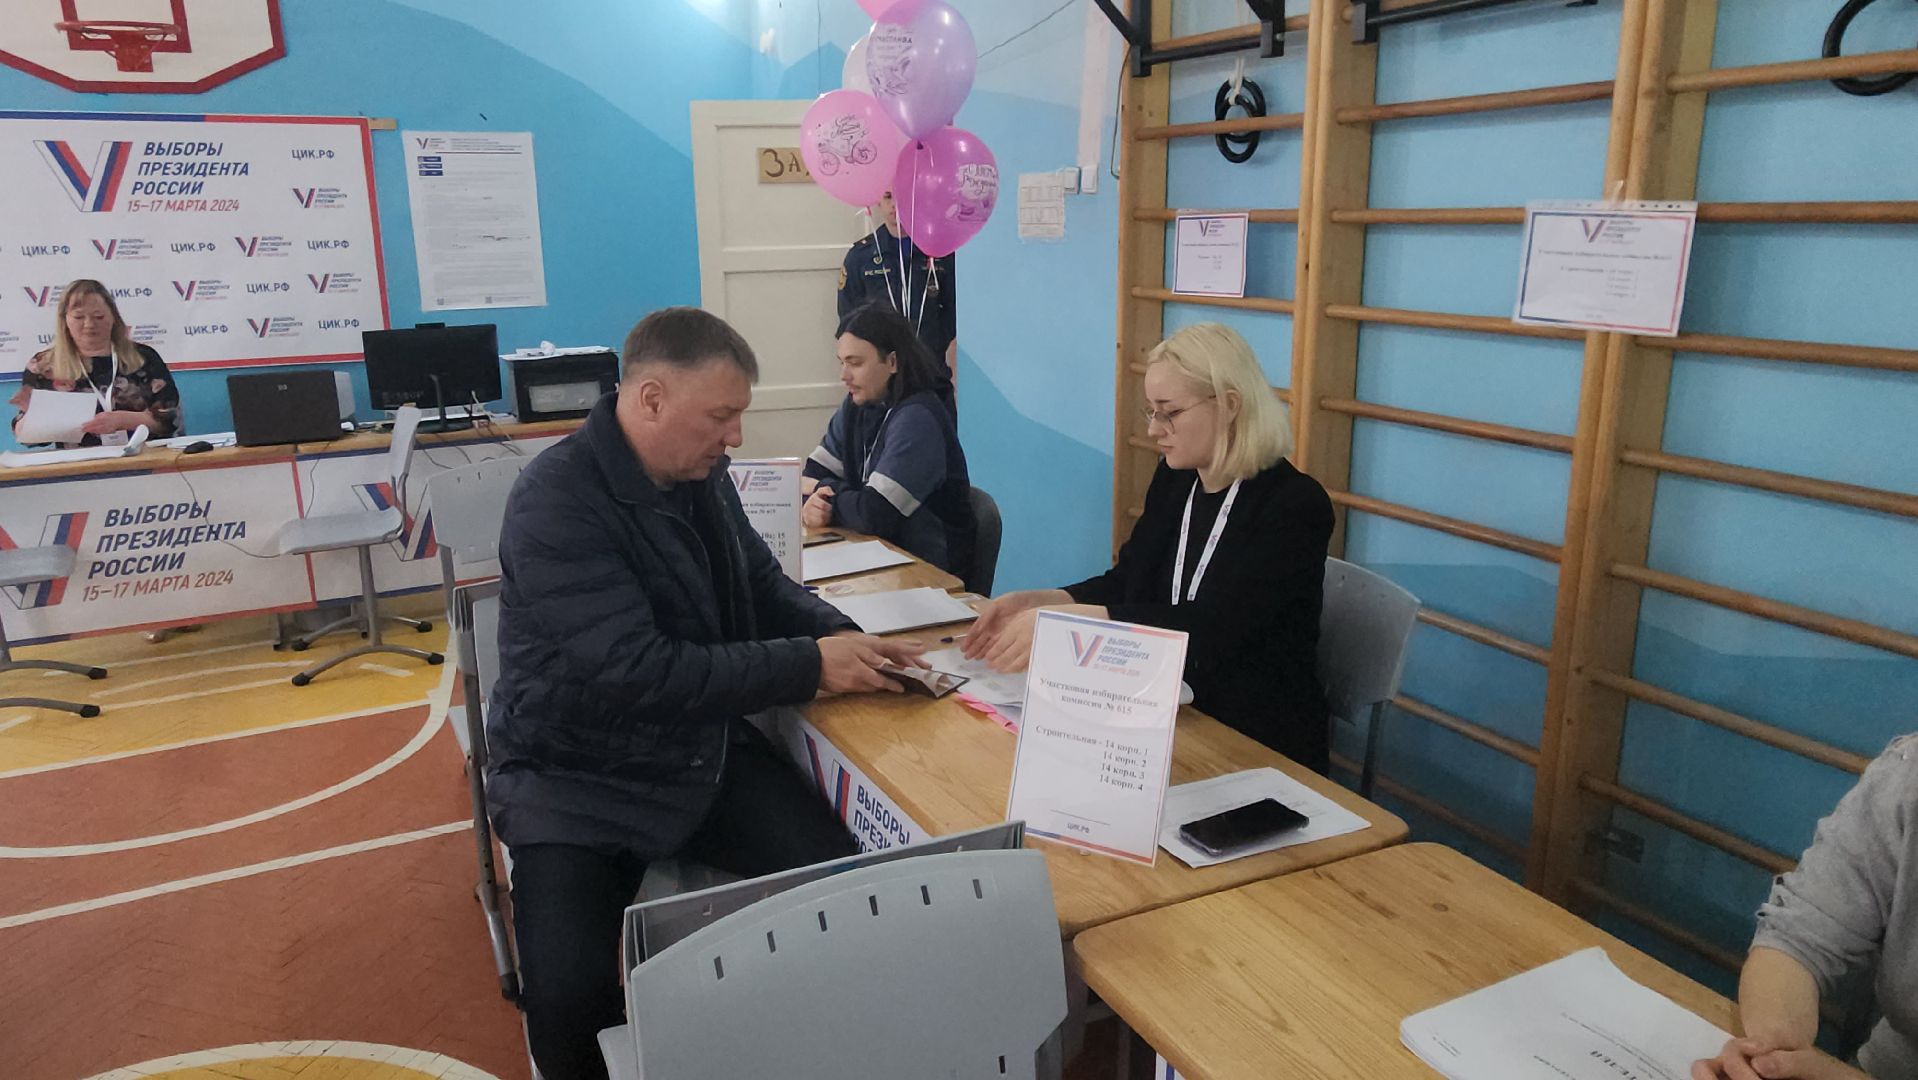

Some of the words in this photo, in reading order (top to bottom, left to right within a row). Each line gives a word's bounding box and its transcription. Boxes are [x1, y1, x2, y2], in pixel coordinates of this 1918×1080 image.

[143, 141, 223, 156] ВЫБОРЫ
[291, 149, 335, 160] ЦИК.РФ
[137, 161, 249, 177] ПРЕЗИДЕНТА
[763, 148, 809, 177] ЗА
[131, 181, 204, 195] РОССИИ
[164, 199, 207, 212] МАРТА
[209, 199, 240, 212] 2024
[20, 245, 71, 257] ЦИК.РФ
[170, 242, 216, 254] ЦИК.РФ
[307, 240, 350, 251] ЦИК.РФ
[246, 282, 290, 294] ЦИК.РФ
[184, 324, 228, 336] ЦИК.РФ
[318, 319, 360, 330] ЦИК.РФ
[104, 500, 212, 528] ВЫБОРЫ
[96, 521, 246, 553] ПРЕЗИДЕНТА
[88, 552, 186, 579] РОССИИ
[133, 575, 190, 596] МАРТА
[194, 569, 234, 588] 2024
[1107, 637, 1142, 649] ВЫБОРЫ
[1101, 645, 1150, 660] ПРЕЗИДЕНТА
[1096, 655, 1128, 666] РОССИИ
[1040, 678, 1090, 694] Участковая
[1092, 689, 1159, 708] избирательная
[1061, 695, 1102, 709] комиссия
[1036, 725, 1097, 745] Строительная
[1105, 739, 1115, 749] 14
[1103, 750, 1113, 760] 14
[1142, 759, 1147, 768] 2
[1102, 763, 1111, 772] 14
[1113, 767, 1137, 778] корп.
[1100, 774, 1109, 784] 14
[1111, 779, 1135, 789] корп.
[1137, 783, 1143, 791] 4
[857, 784, 910, 846] ВЫБОРЫ
